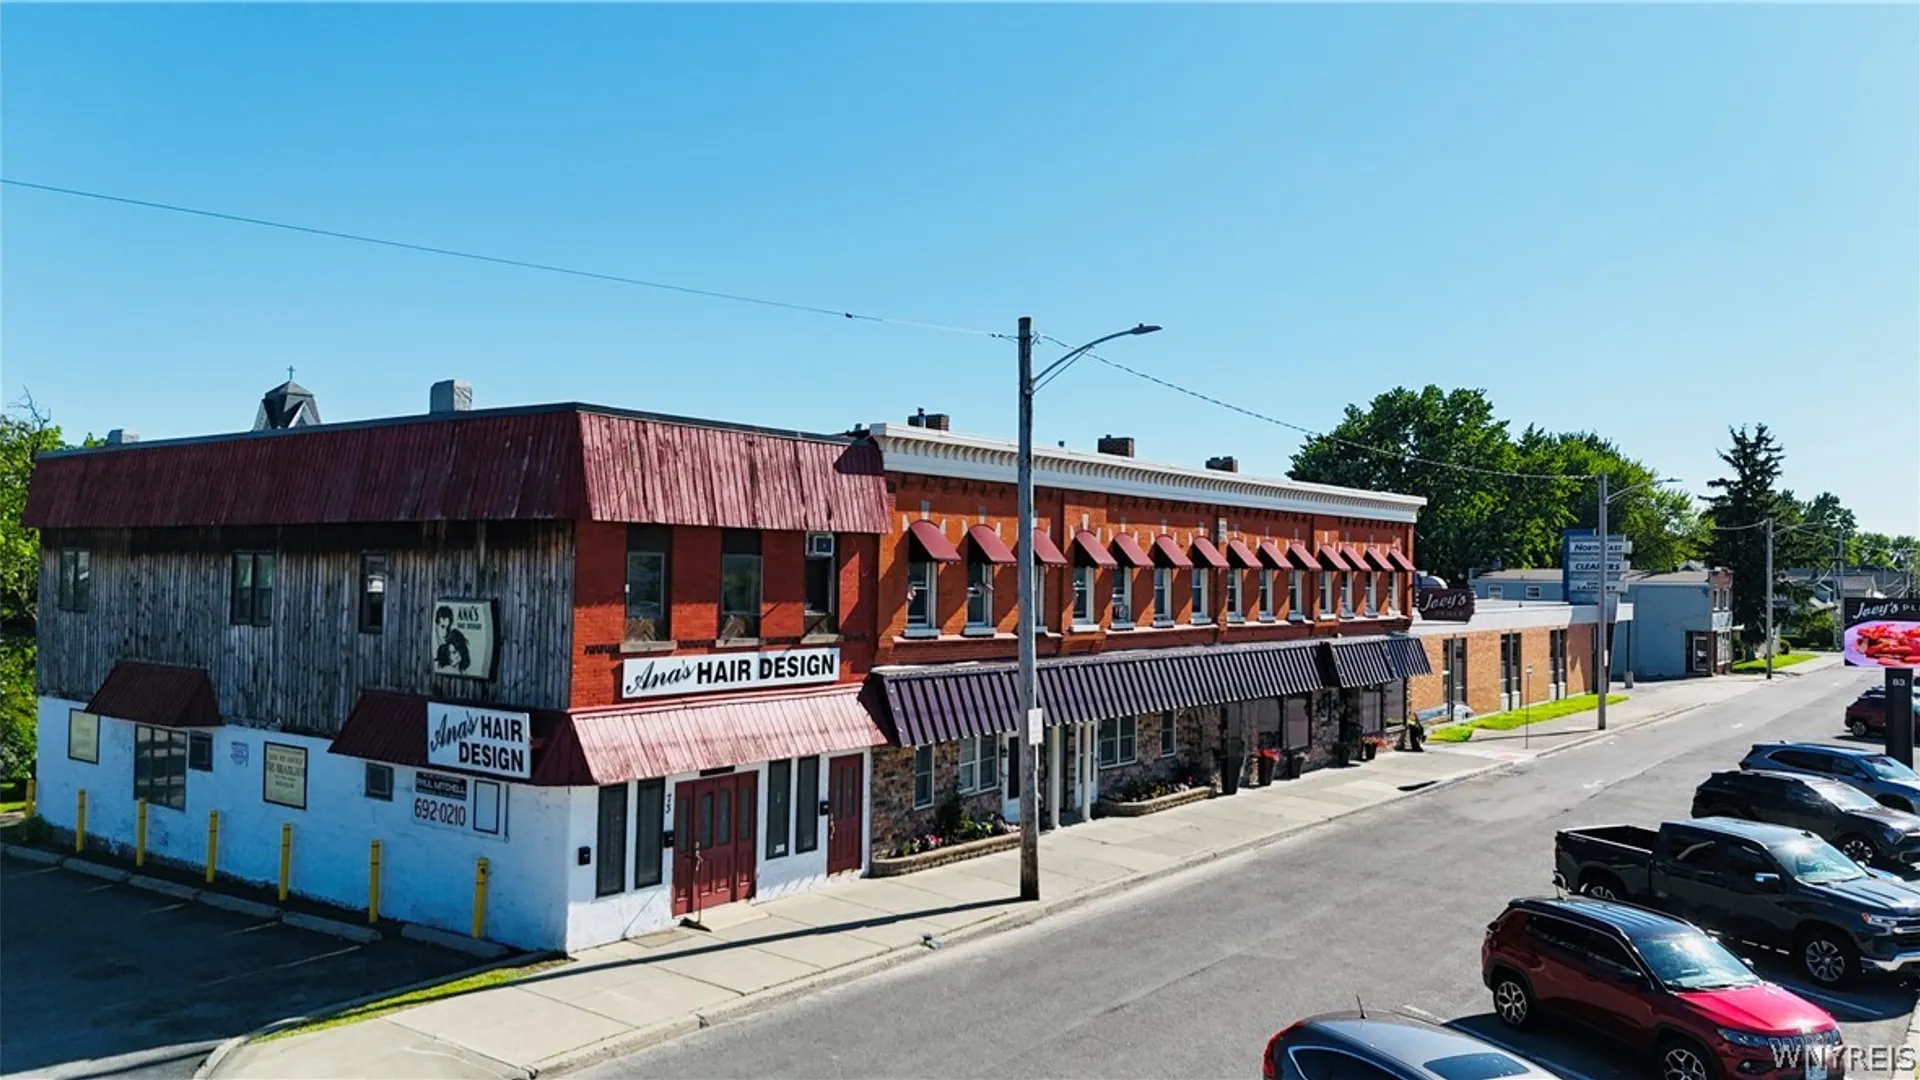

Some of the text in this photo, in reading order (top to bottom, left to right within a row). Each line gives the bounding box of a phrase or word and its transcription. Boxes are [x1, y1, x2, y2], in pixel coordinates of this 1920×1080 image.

[1575, 562, 1620, 570] CLEARS
[1420, 592, 1466, 611] Joey's
[1852, 602, 1920, 619] Joey's PL
[626, 653, 835, 693] Ana's HAIR DESIGN
[1892, 678, 1906, 686] 83
[430, 710, 523, 753] Ana's HAIR
[458, 741, 525, 773] DESIGN
[414, 797, 467, 827] 692-0210
